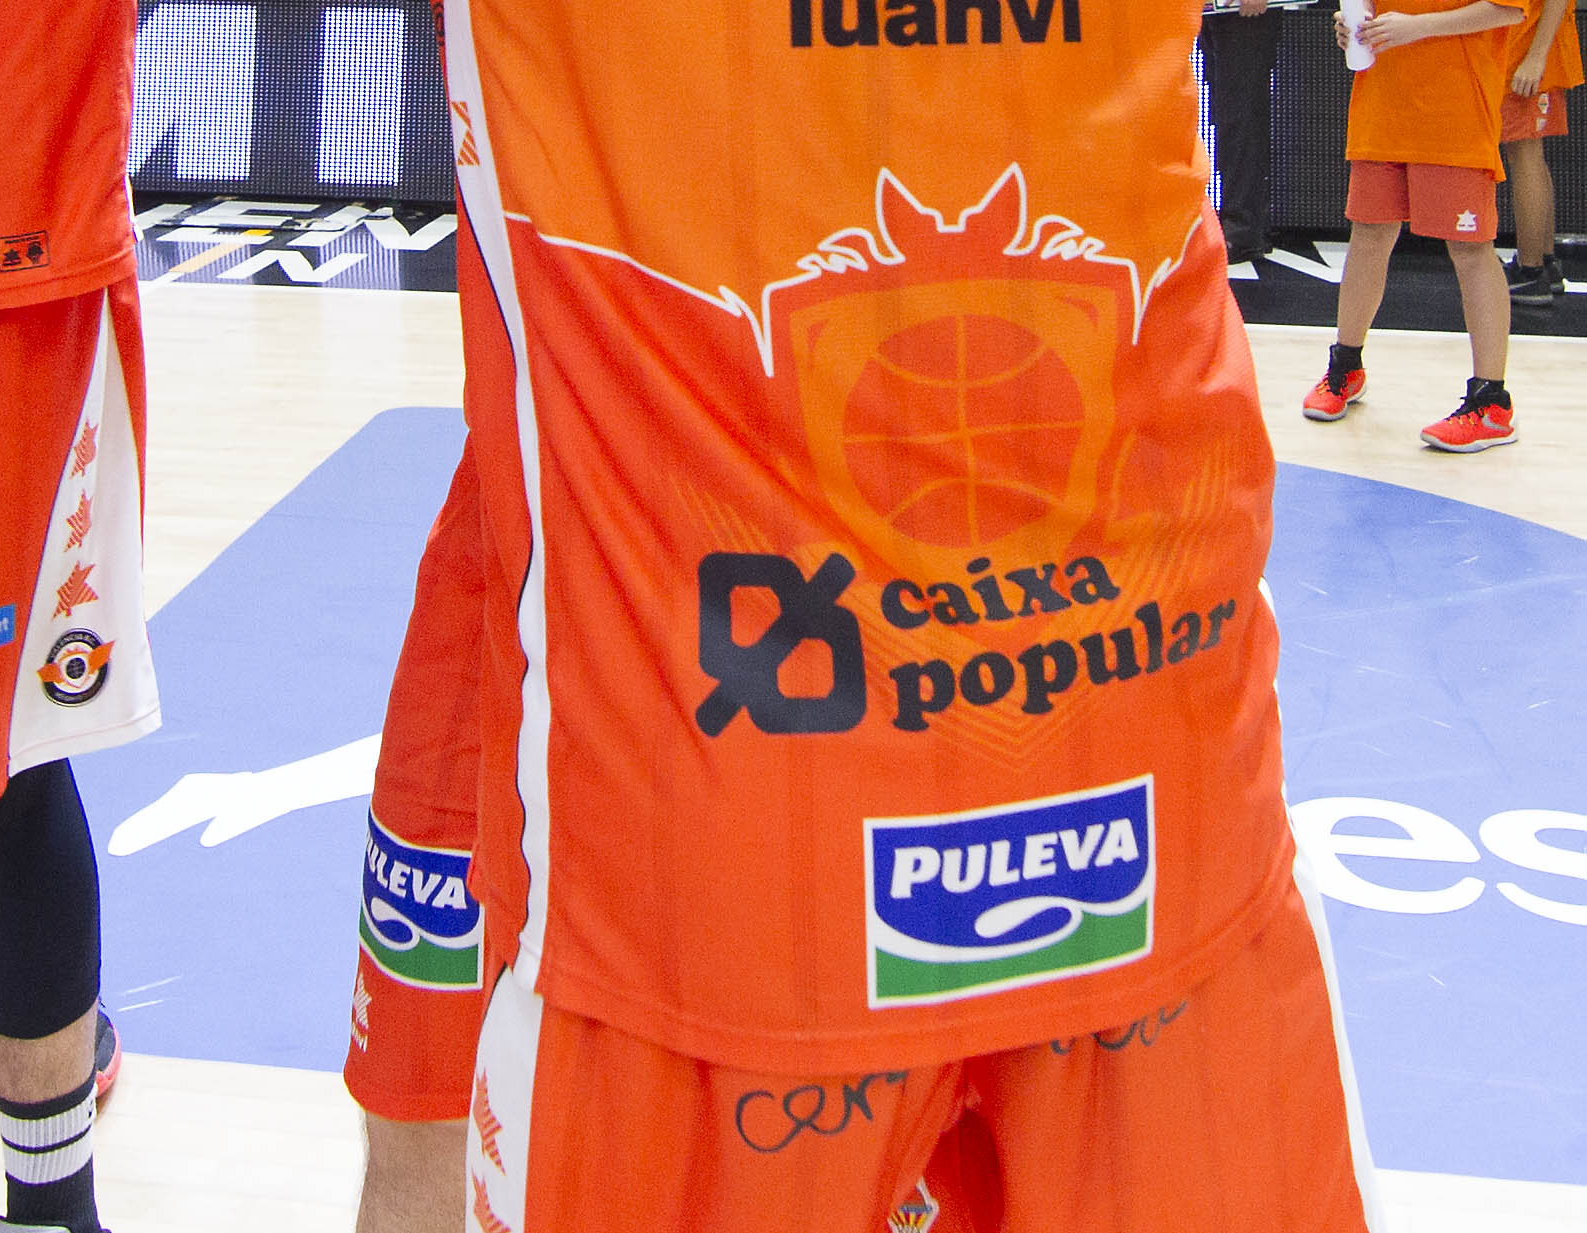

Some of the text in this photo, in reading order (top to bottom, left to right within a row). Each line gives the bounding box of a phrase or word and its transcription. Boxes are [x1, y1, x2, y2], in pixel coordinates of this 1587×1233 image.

[880, 556, 1121, 630] caixa
[888, 599, 1237, 732] popular
[366, 830, 467, 910] ULEVA
[890, 818, 1139, 899] PULEVA
